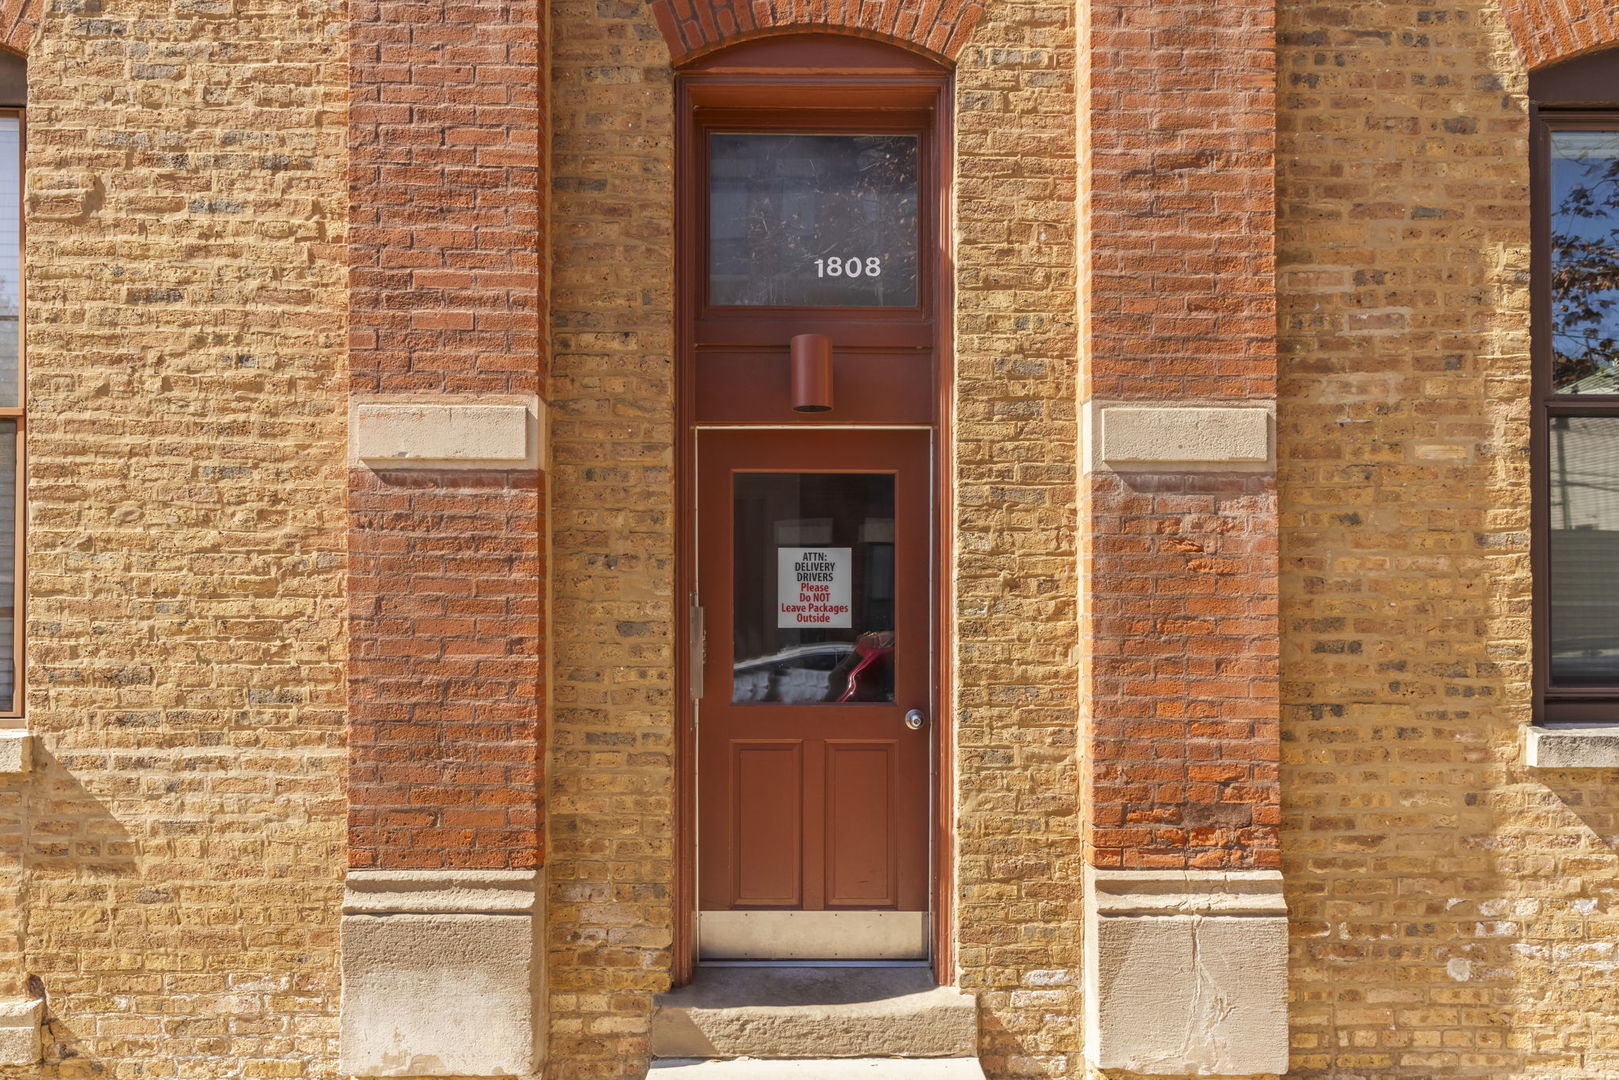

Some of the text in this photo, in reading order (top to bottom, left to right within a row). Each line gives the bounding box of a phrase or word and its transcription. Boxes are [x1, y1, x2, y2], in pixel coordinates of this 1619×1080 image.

[814, 257, 881, 278] 1808
[802, 552, 827, 561] ATTN:
[795, 562, 835, 571] DELIVERY
[797, 573, 833, 582] DRIVERS
[801, 583, 829, 592] Please
[800, 593, 831, 602] Do NOT
[781, 603, 849, 615] Leave Packages
[797, 613, 830, 622] Outside
